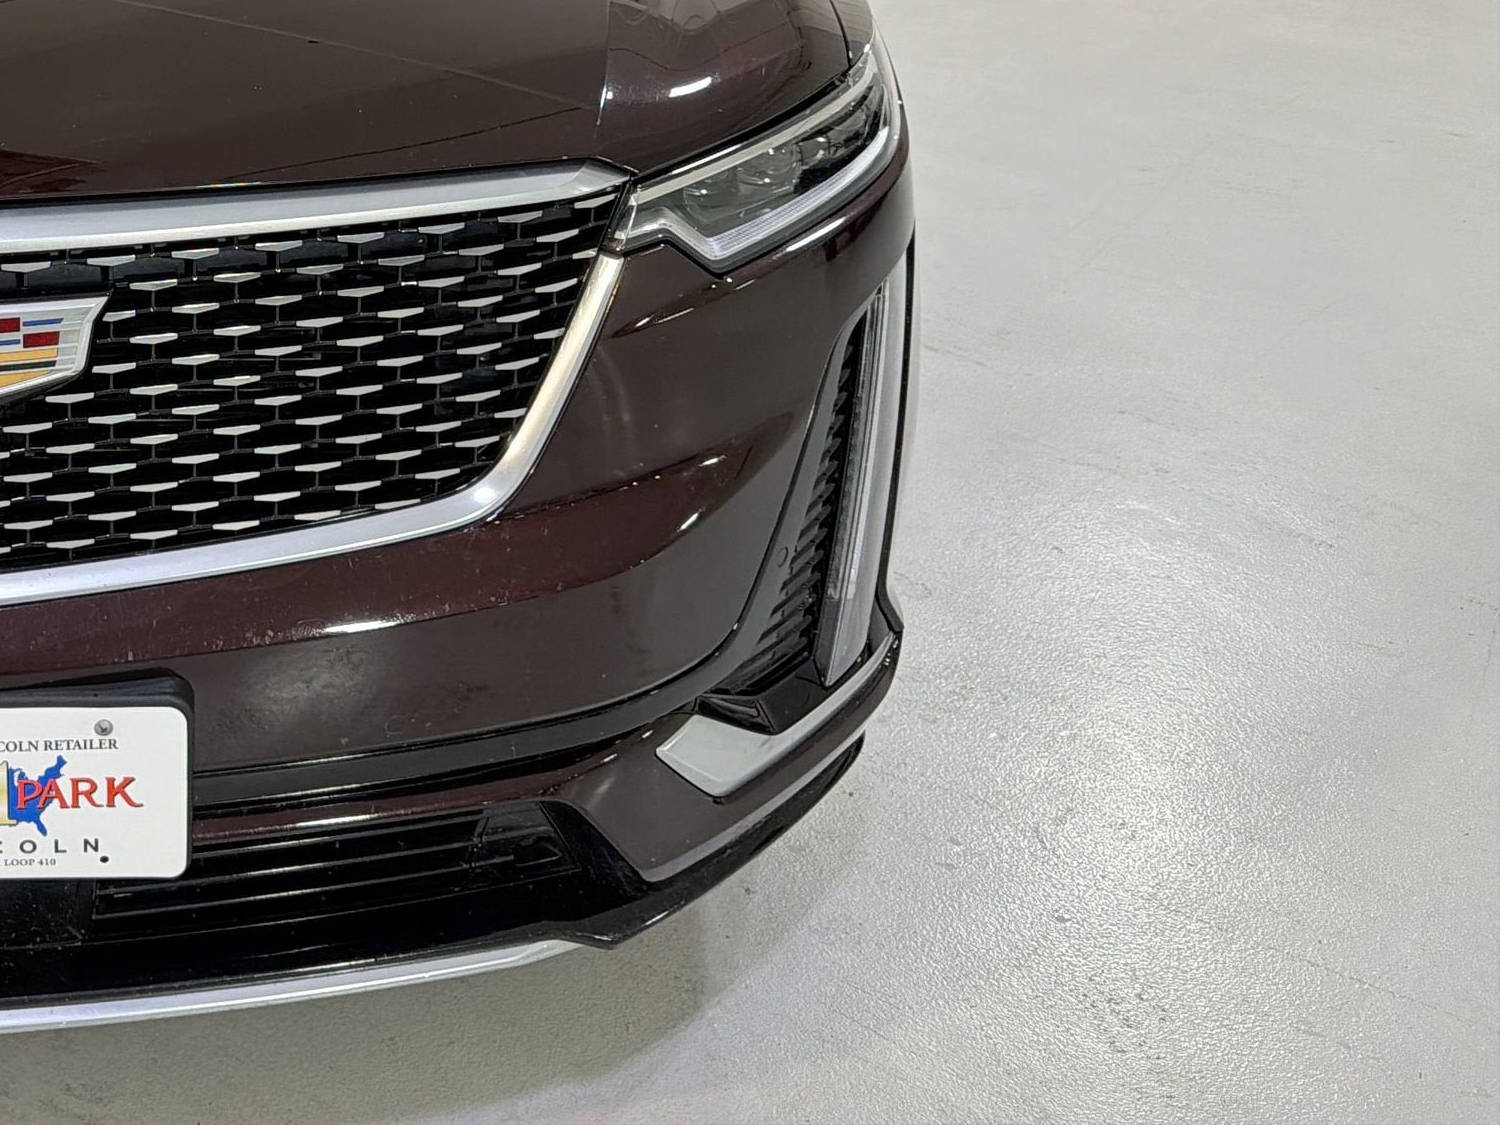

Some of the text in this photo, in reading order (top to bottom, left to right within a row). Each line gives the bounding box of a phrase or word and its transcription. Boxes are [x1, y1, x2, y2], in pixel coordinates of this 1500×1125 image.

[43, 738, 119, 752] RETAILER
[16, 776, 144, 810] PARK
[3, 857, 36, 867] LOOP
[38, 857, 57, 866] 410
